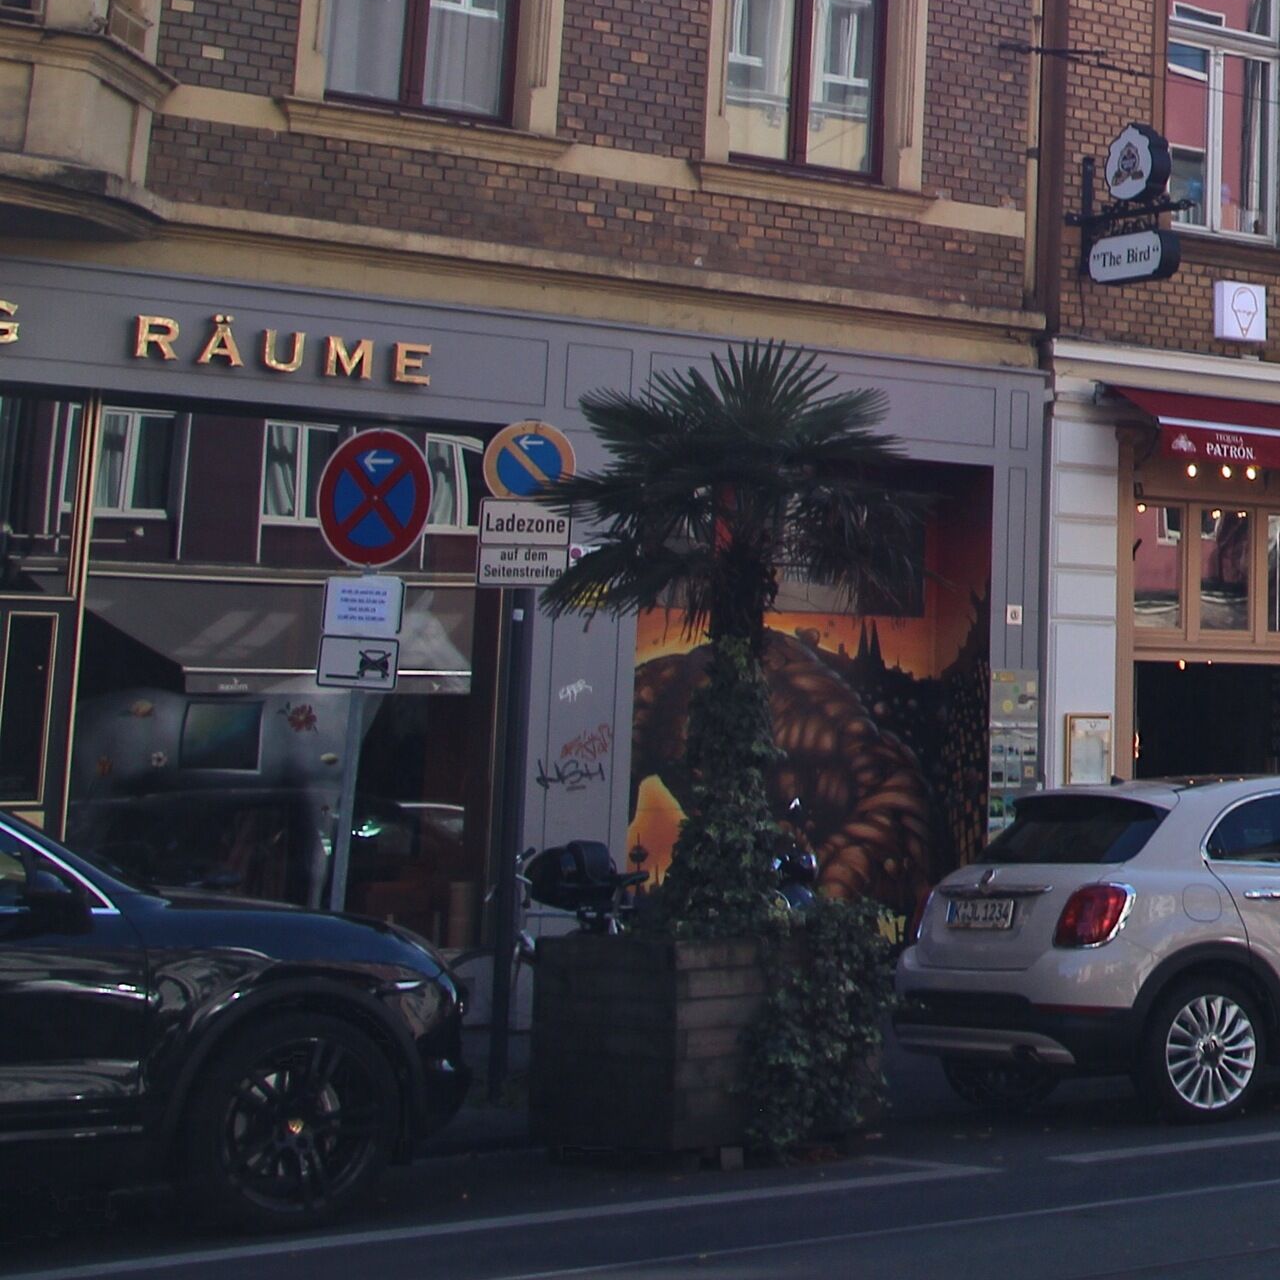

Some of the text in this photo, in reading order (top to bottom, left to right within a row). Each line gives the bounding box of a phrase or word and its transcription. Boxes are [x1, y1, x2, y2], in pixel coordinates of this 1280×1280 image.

[134, 313, 432, 386] RÄUME
[1206, 441, 1256, 460] PATRÓN
[485, 513, 565, 533] Ladezone
[500, 547, 548, 561] auf dem
[483, 563, 564, 578] Seitenstreifen
